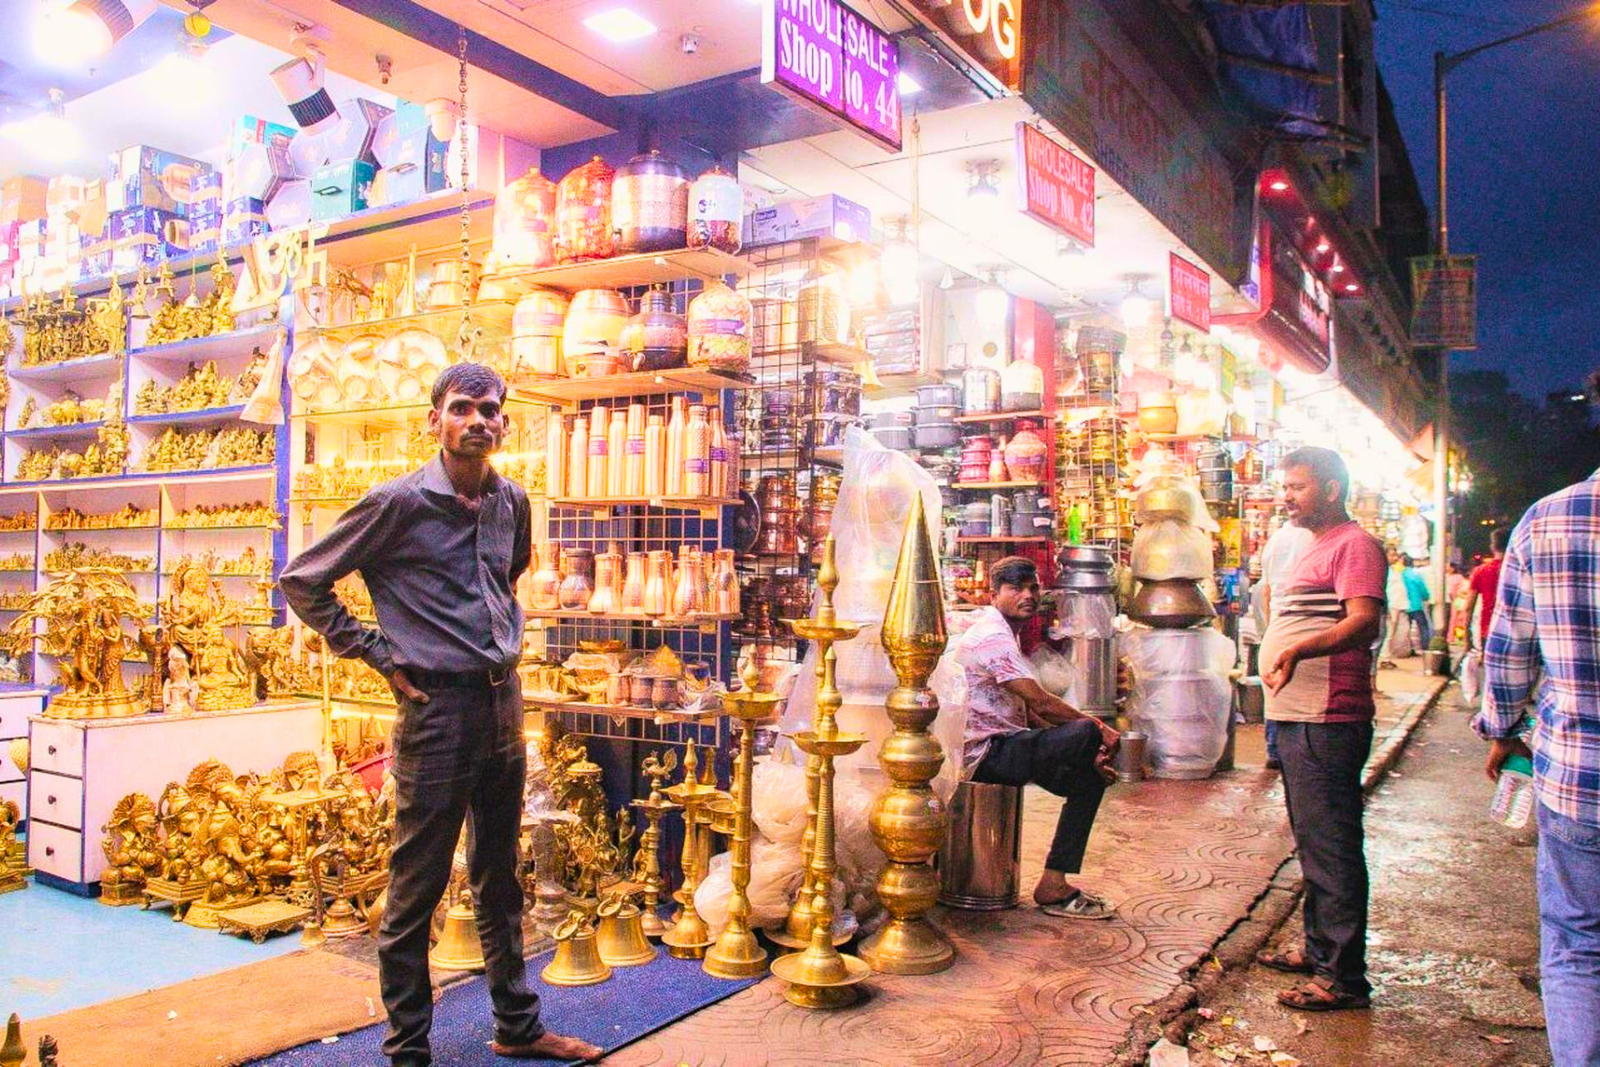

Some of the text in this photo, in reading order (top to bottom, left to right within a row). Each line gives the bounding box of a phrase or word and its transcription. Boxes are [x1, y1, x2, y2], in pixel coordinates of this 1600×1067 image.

[780, 16, 833, 98] Shop
[875, 80, 898, 131] 44
[1029, 166, 1094, 232] Shop No. 42
